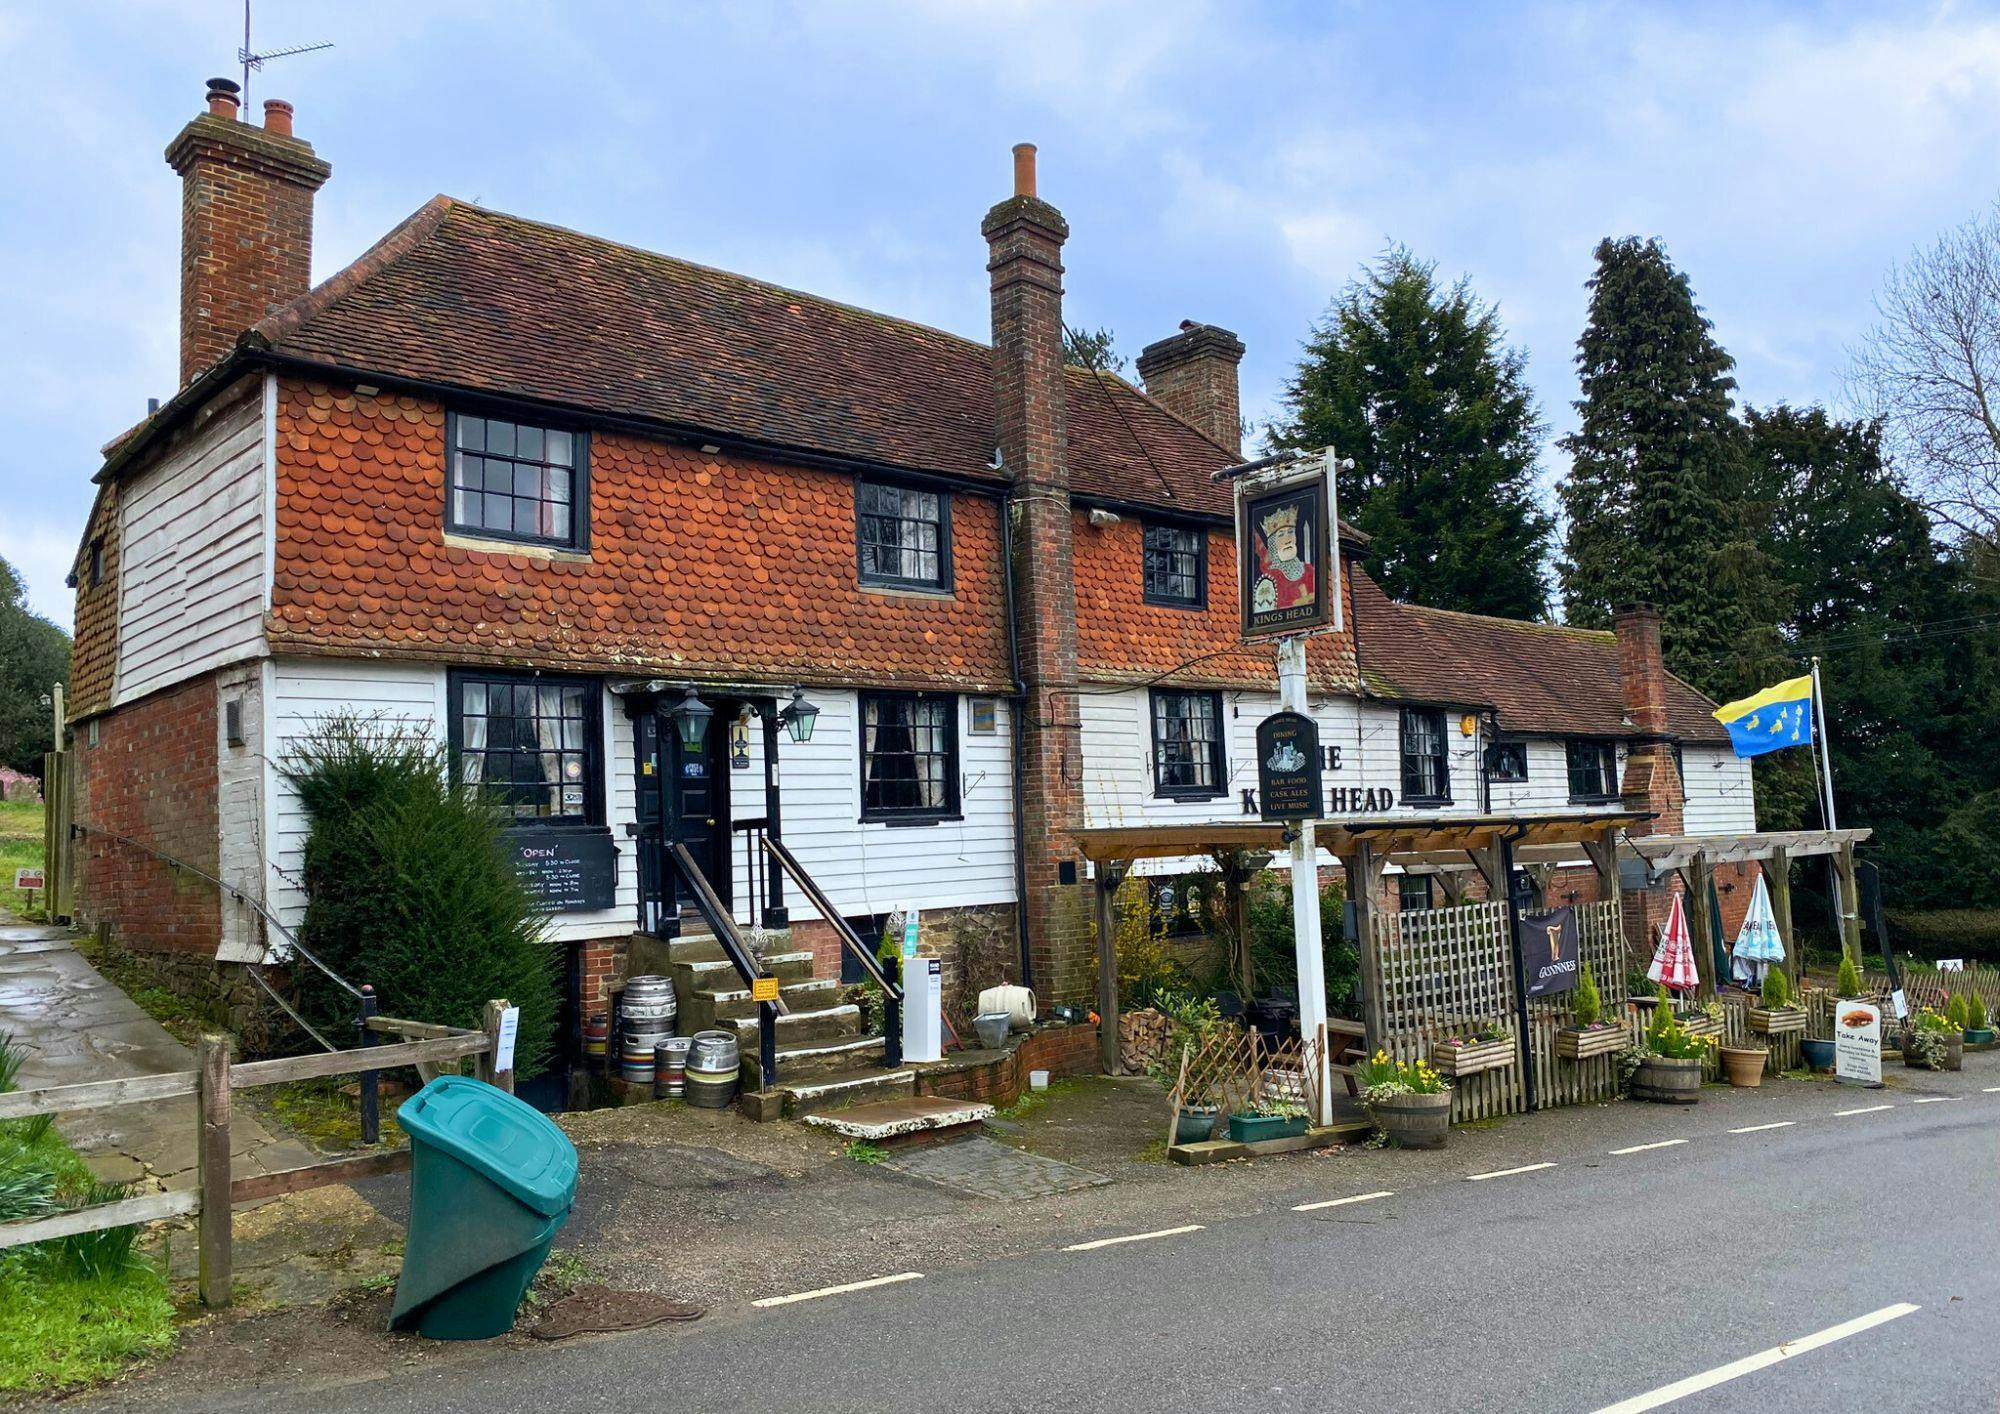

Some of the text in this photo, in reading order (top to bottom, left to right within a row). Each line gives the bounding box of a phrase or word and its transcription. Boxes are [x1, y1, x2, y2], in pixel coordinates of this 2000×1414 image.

[1254, 607, 1313, 624] KINGS HEAD
[1273, 729, 1297, 739] DINING
[1288, 777, 1307, 785] FOOD
[1270, 789, 1308, 799] CASK ALES
[1331, 787, 1393, 813] HEAD
[1270, 801, 1310, 811] LIVE MUSIC
[1538, 960, 1576, 979] GUINNES
[1836, 1031, 1879, 1046] Take Away
